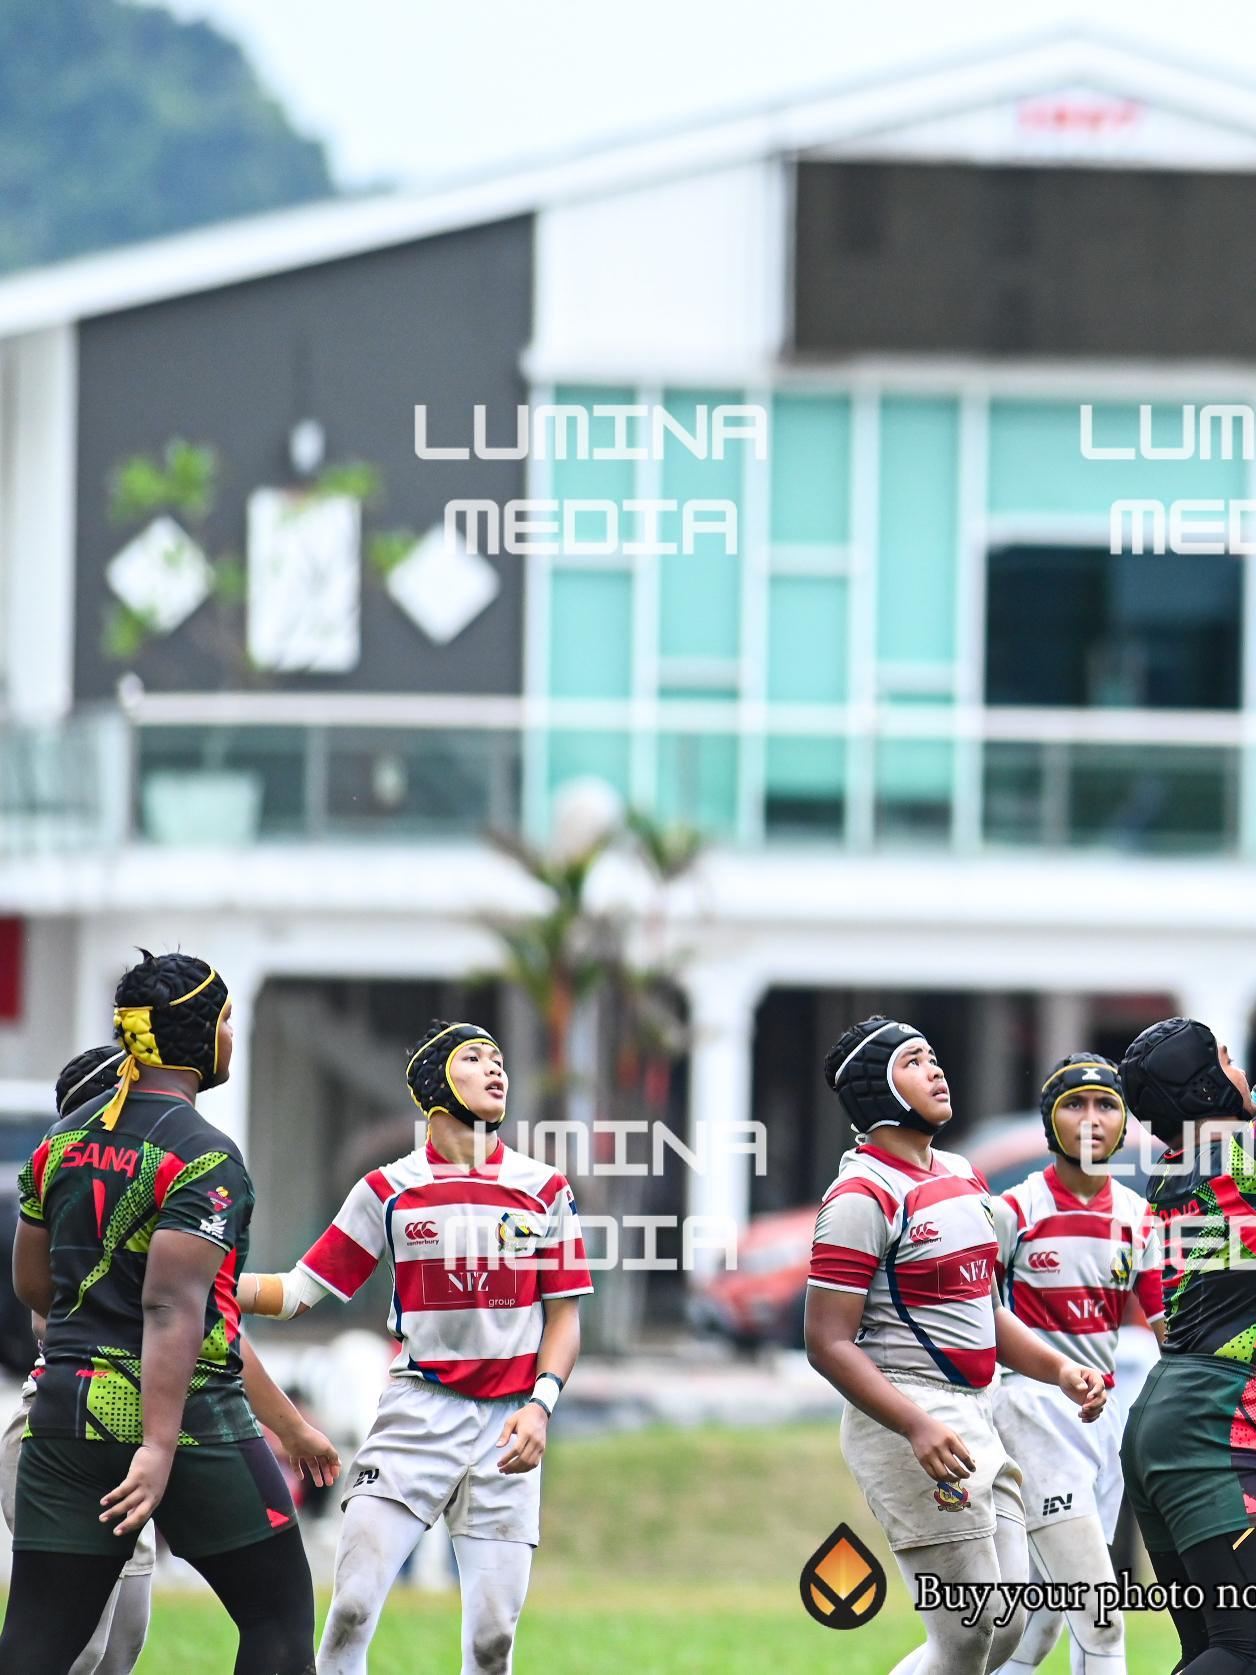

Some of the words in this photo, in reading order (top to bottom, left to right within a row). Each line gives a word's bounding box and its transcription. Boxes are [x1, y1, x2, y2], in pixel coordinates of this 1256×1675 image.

[406, 1238, 440, 1247] canterbury
[448, 1272, 489, 1292] NFZ
[488, 1298, 516, 1308] group
